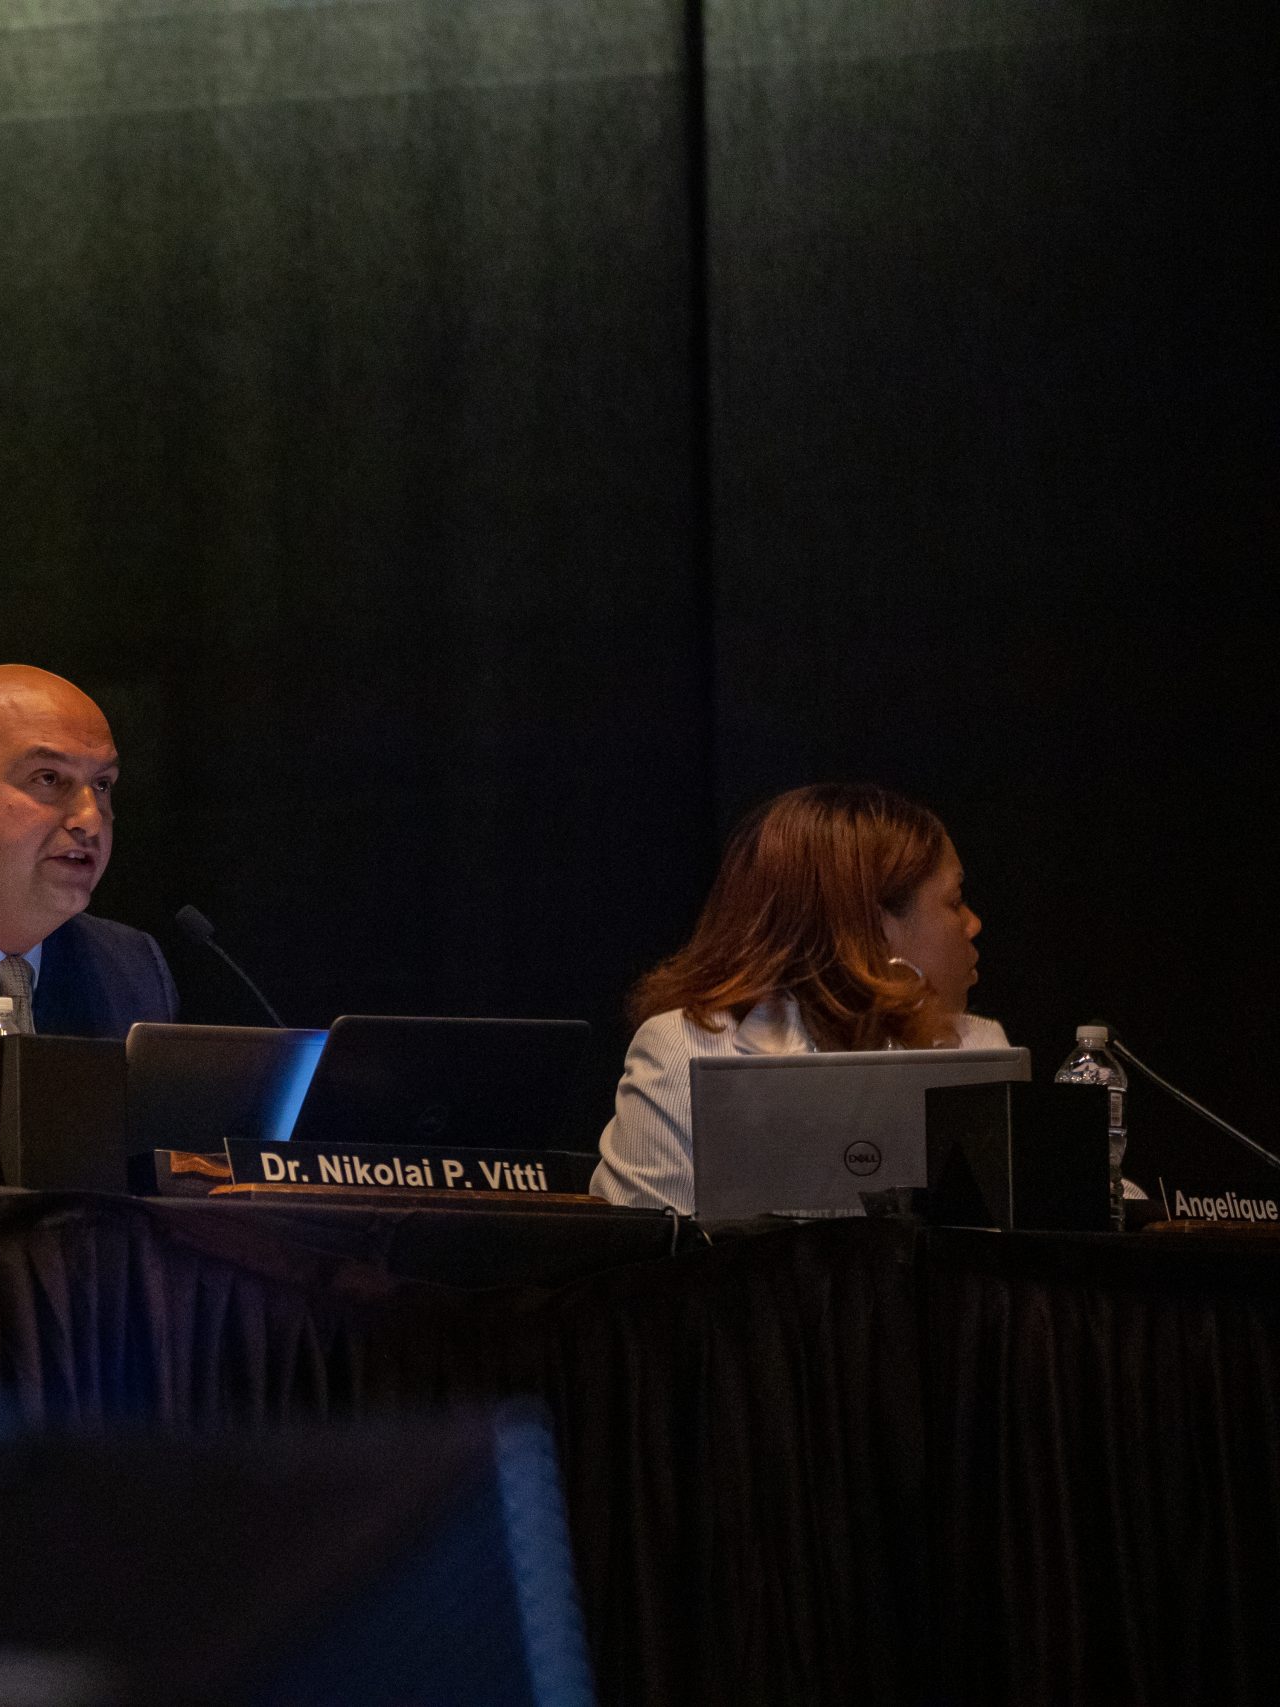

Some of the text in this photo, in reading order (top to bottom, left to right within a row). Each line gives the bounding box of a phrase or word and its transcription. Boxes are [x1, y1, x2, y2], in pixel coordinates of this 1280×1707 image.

[260, 1152, 549, 1192] Dr. Nikolai P. Vitti
[848, 1154, 878, 1163] DELL
[1175, 1189, 1279, 1223] Angelique
